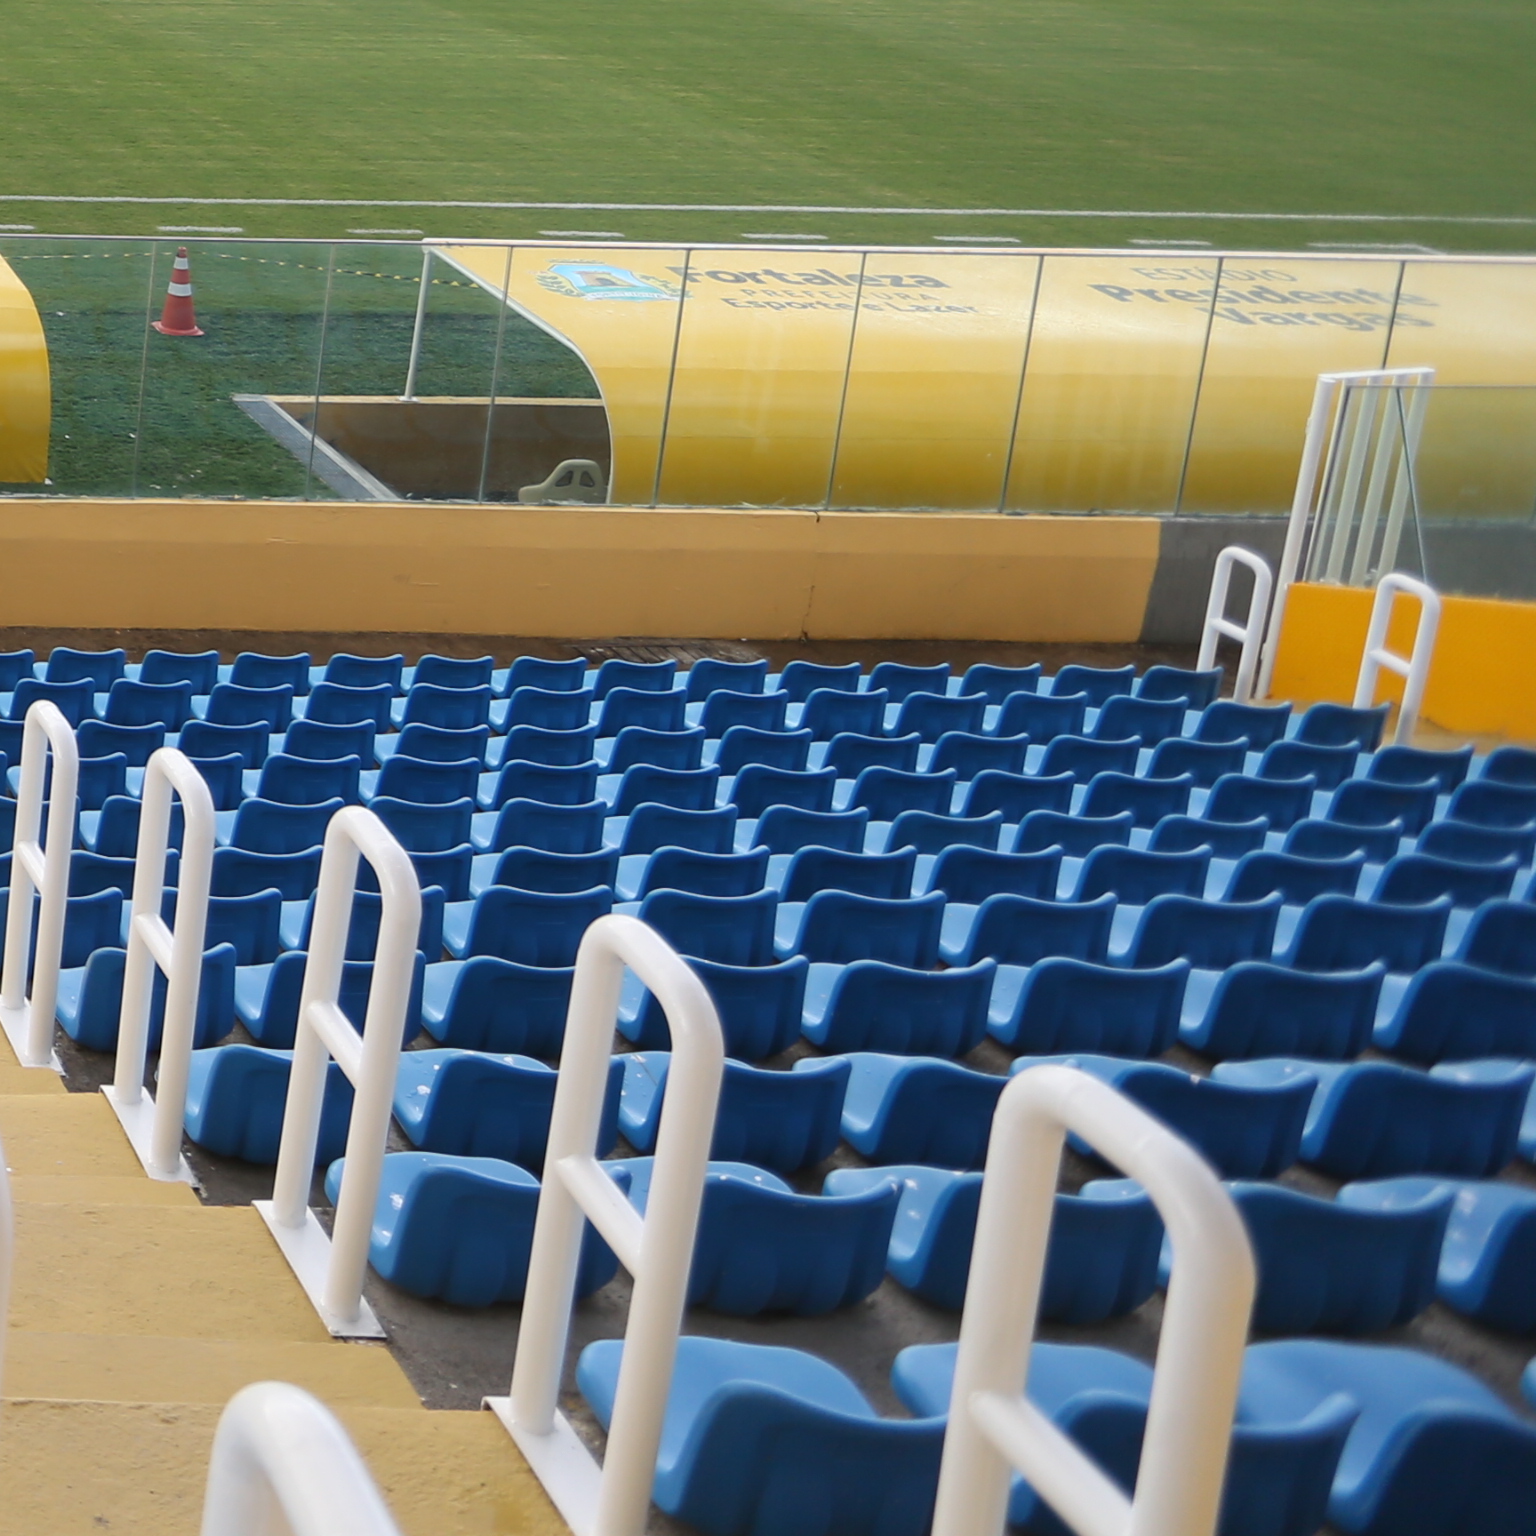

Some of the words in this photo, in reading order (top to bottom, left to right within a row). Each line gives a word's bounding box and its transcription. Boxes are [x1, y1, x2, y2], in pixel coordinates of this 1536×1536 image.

[665, 265, 950, 289] Fortaleza
[1087, 282, 1440, 307] Presidente
[1196, 306, 1434, 331] Vargas
